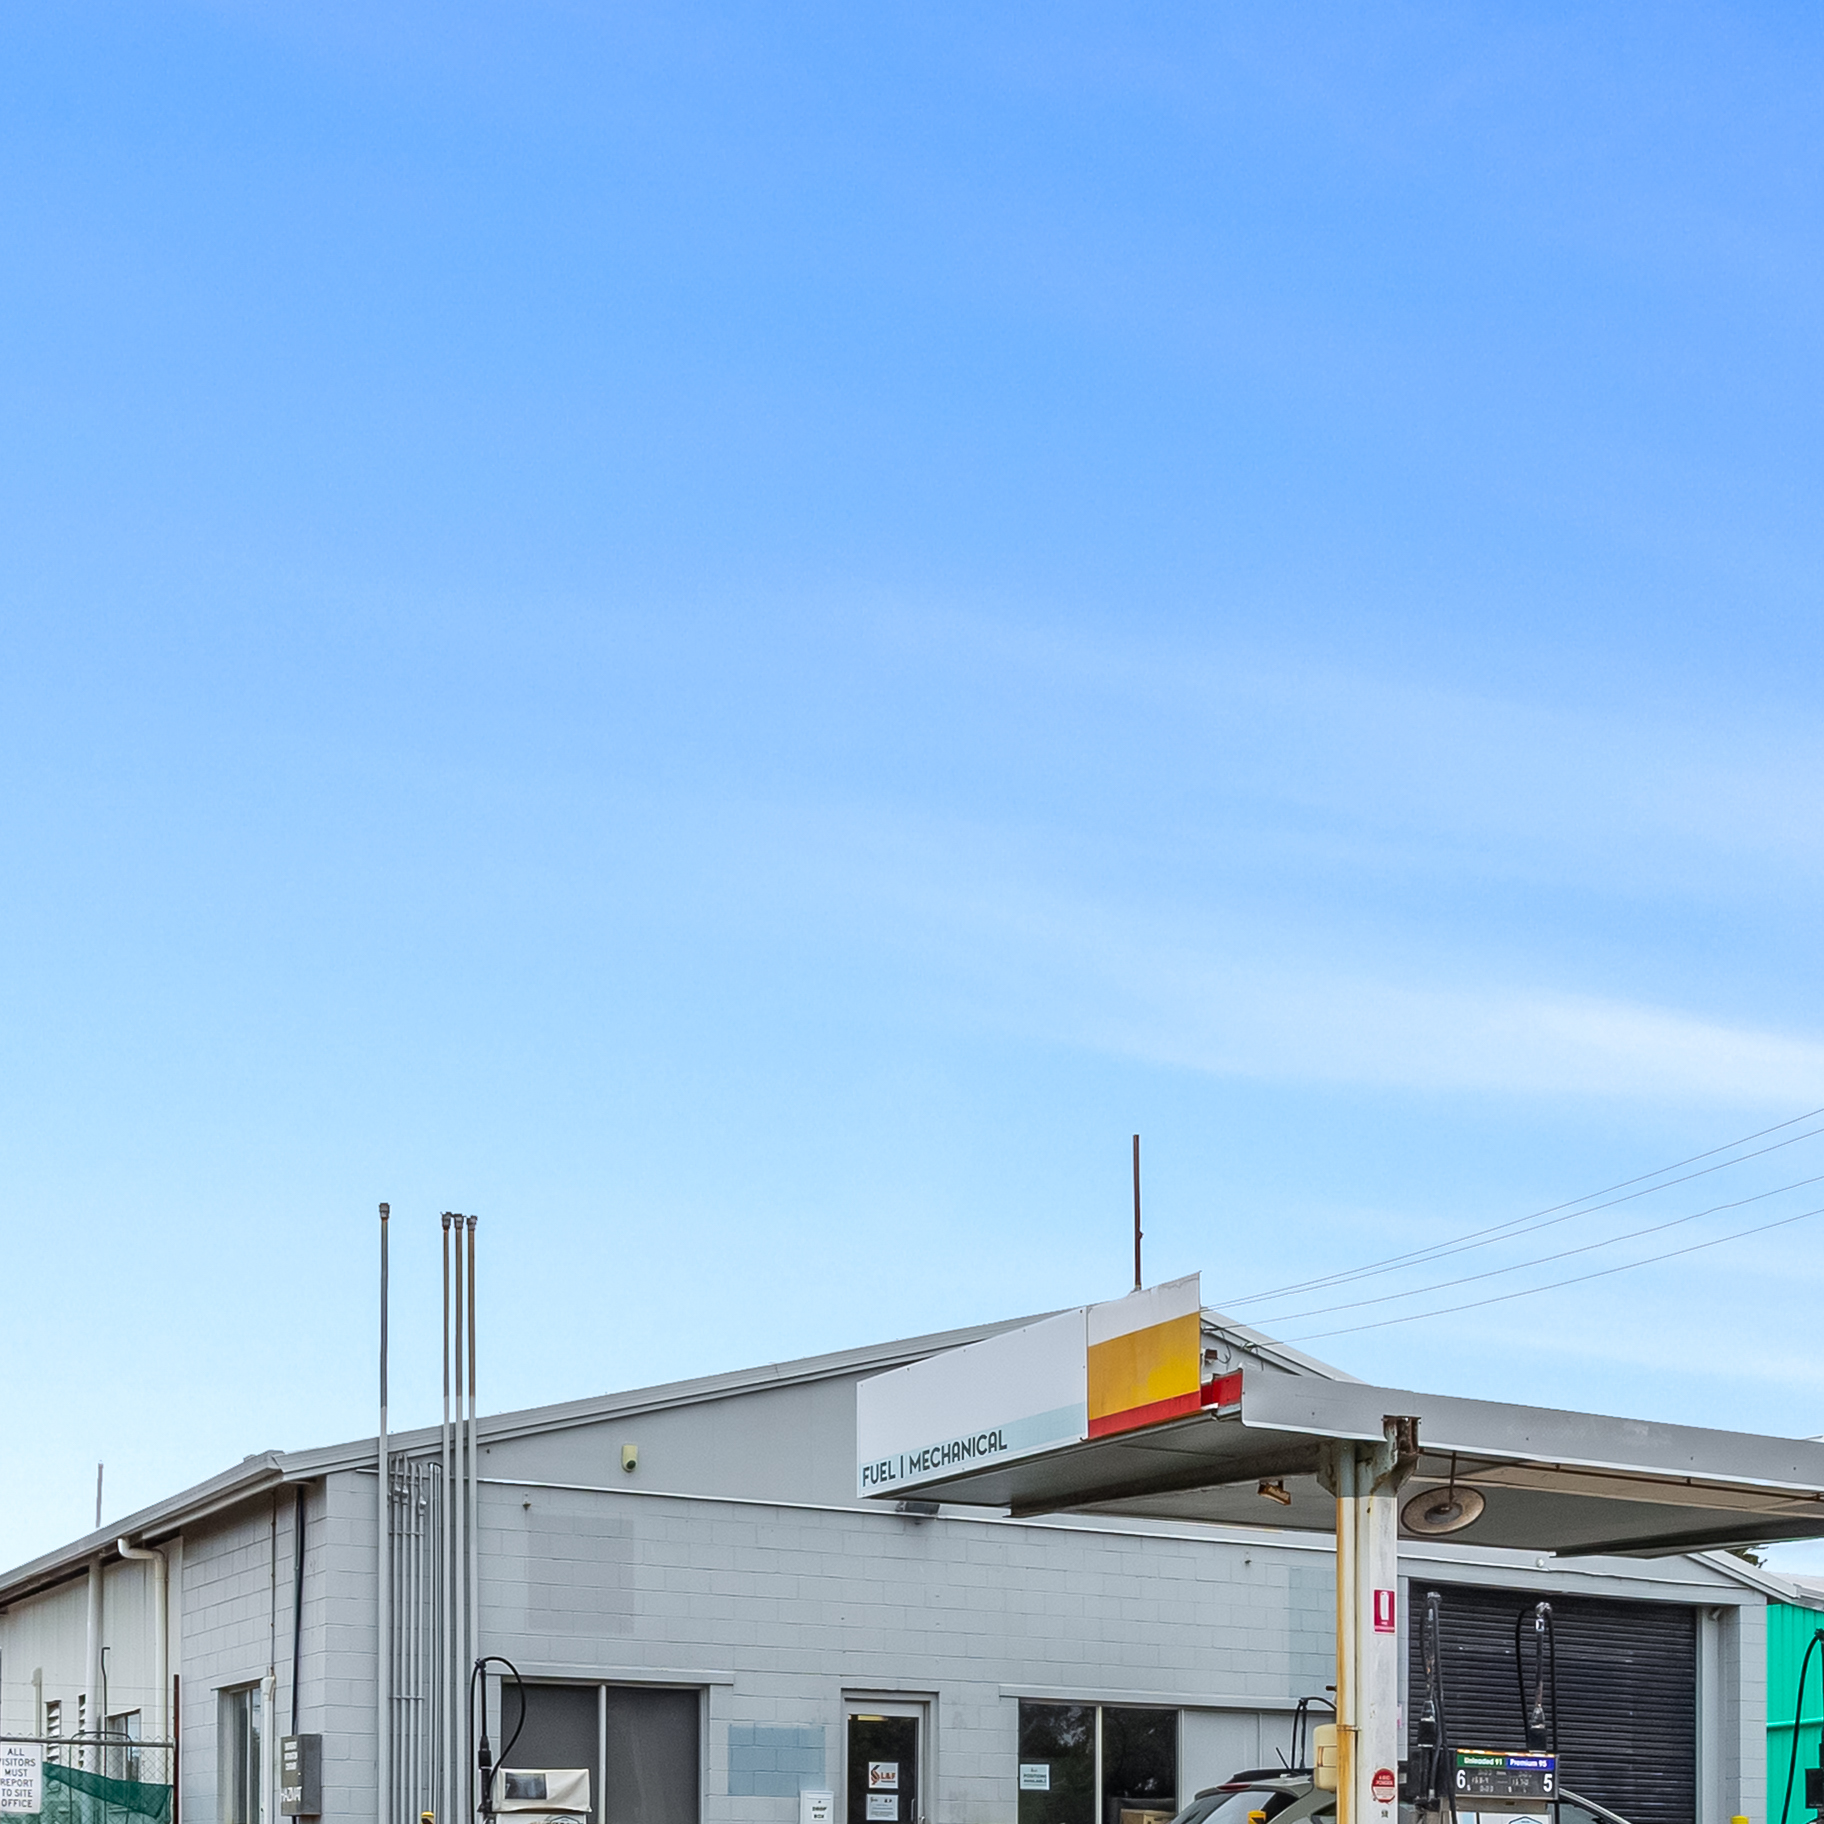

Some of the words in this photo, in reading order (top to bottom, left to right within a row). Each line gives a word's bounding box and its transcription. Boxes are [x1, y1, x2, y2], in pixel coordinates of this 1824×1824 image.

[862, 1460, 896, 1487] FUEL
[909, 1429, 1008, 1475] MECHANICAL
[7, 1748, 25, 1756] ALL
[0, 1758, 36, 1767] ISITORS
[1463, 1757, 1494, 1765] Unleaded
[1509, 1758, 1538, 1767] Premium
[5, 1768, 28, 1777] MUST
[0, 1778, 34, 1787] REPORT
[1456, 1769, 1467, 1789] 6
[1542, 1773, 1553, 1792] 5
[2, 1788, 13, 1797] TO
[14, 1788, 33, 1798] SITE
[1, 1798, 33, 1808] OFFICE
